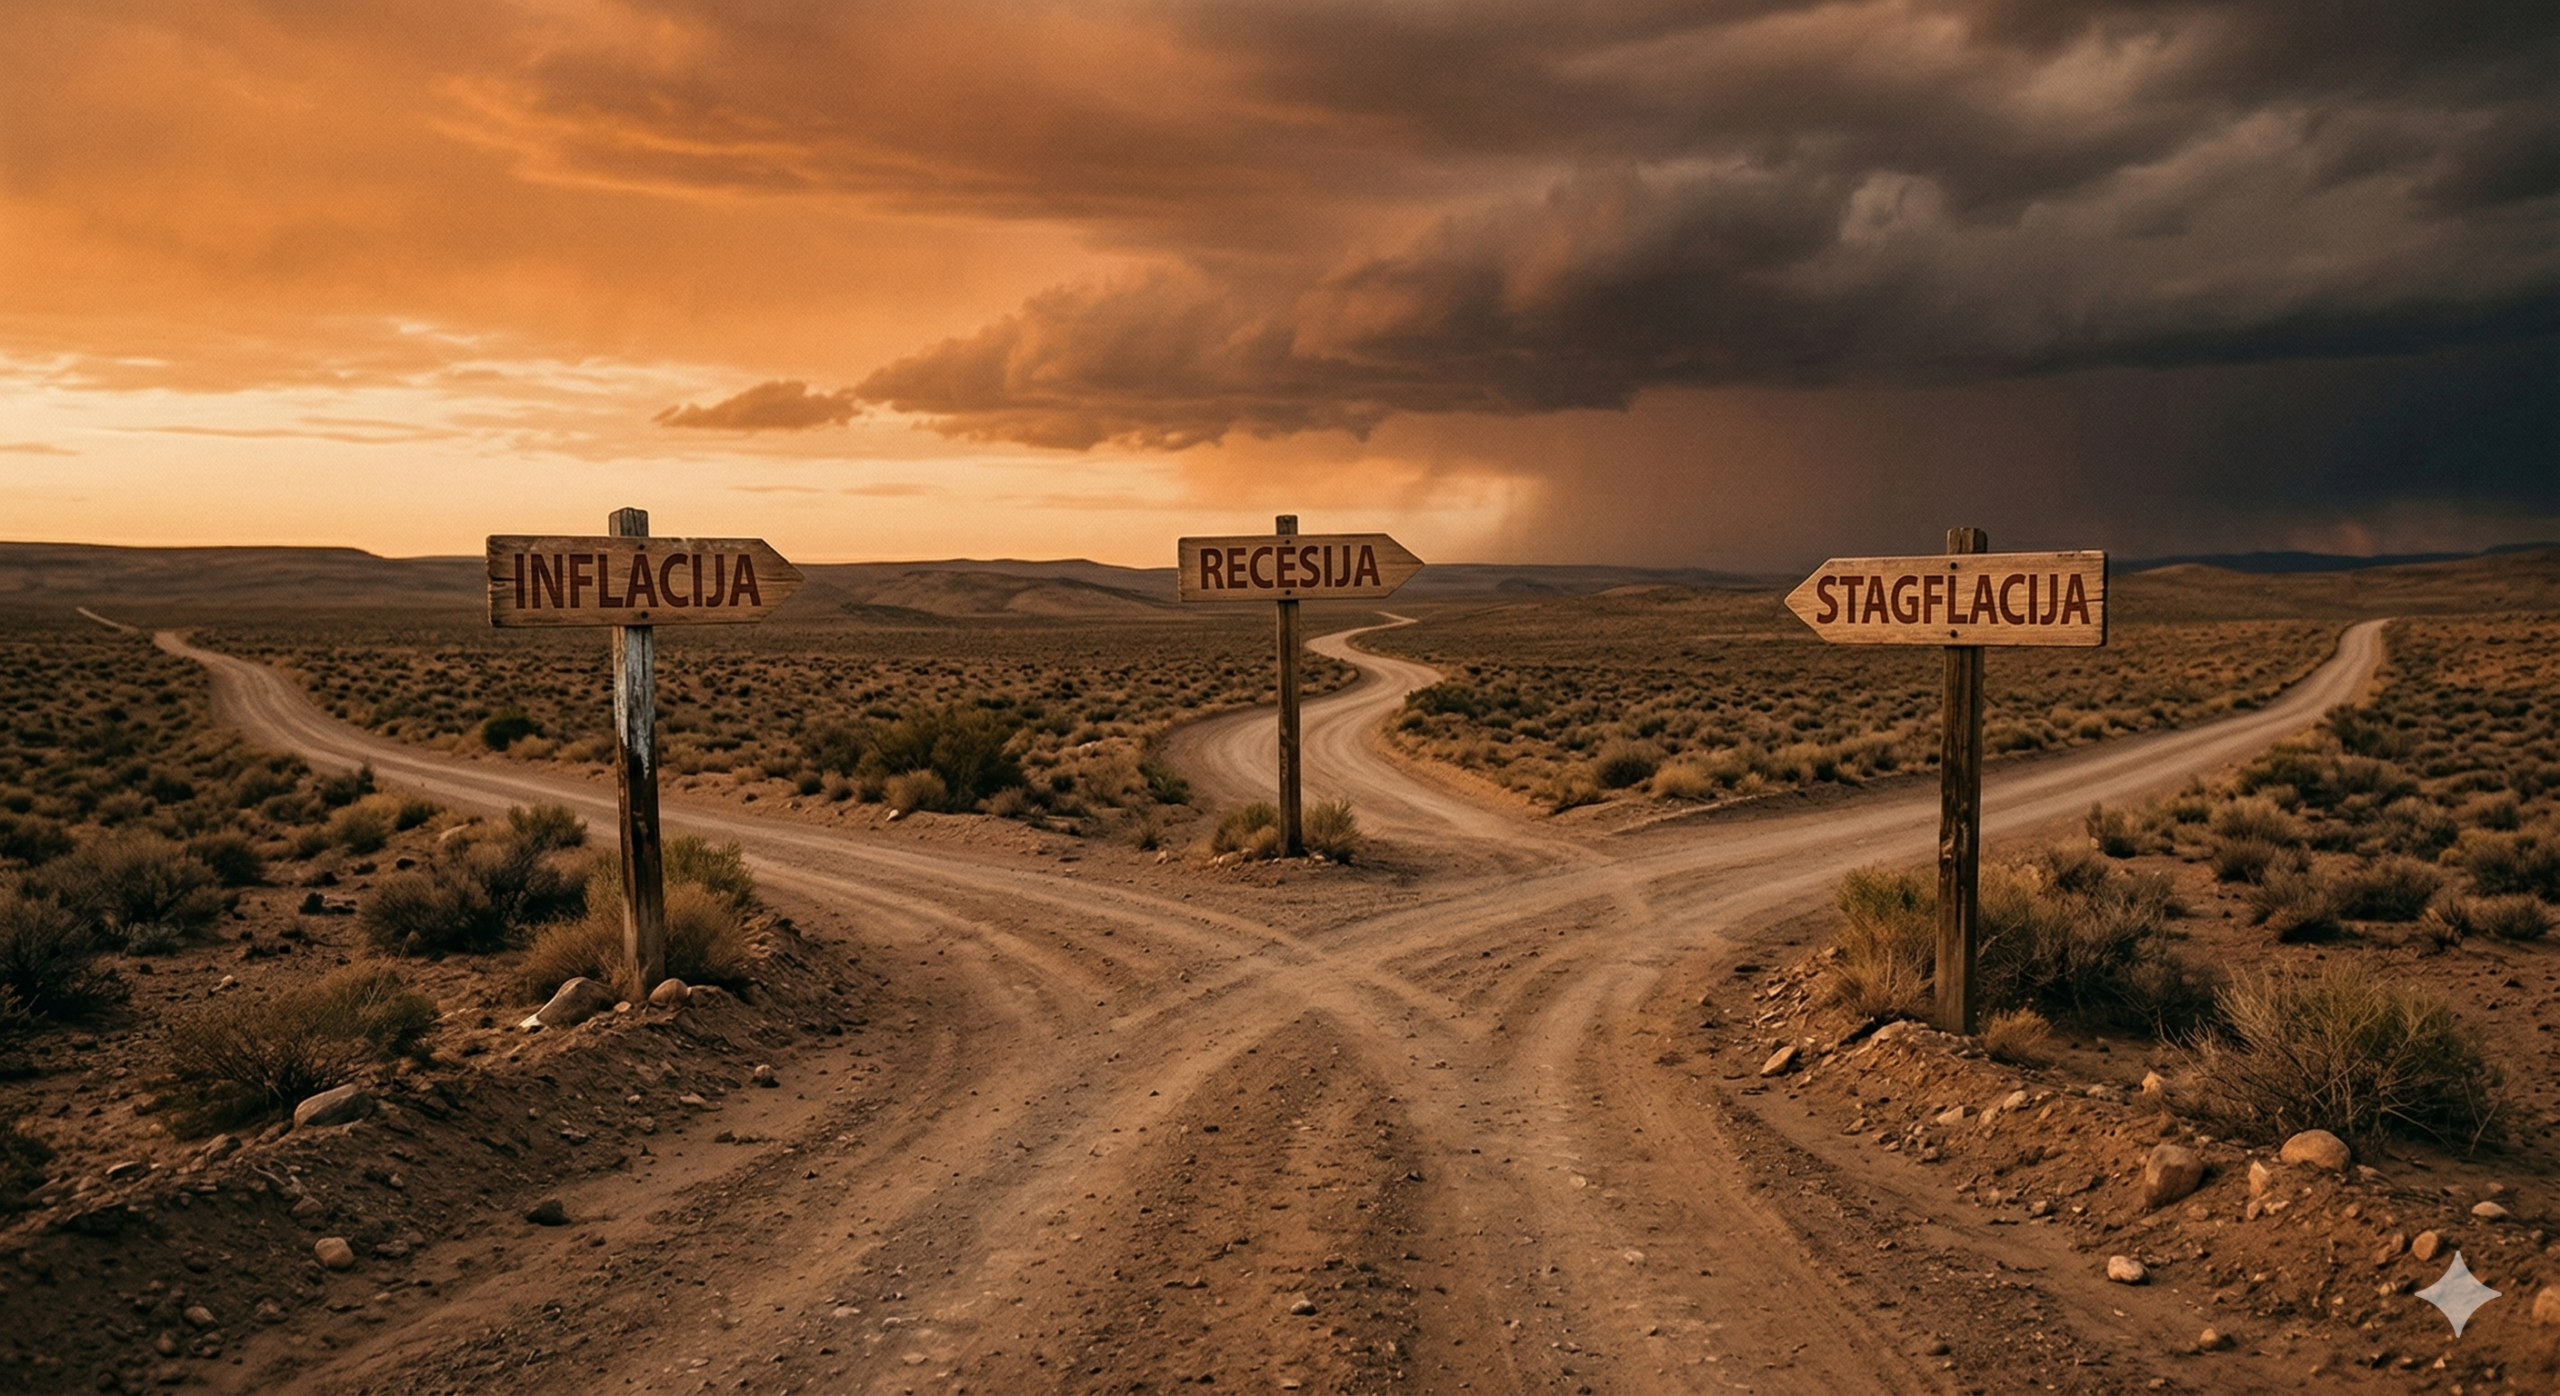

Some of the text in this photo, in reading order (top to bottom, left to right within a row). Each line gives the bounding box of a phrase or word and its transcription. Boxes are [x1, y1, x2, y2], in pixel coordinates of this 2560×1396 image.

[514, 553, 762, 609] INFLACIJA
[1200, 545, 1381, 590] RECESIJA
[1815, 573, 2091, 625] STAGFLACIJA
